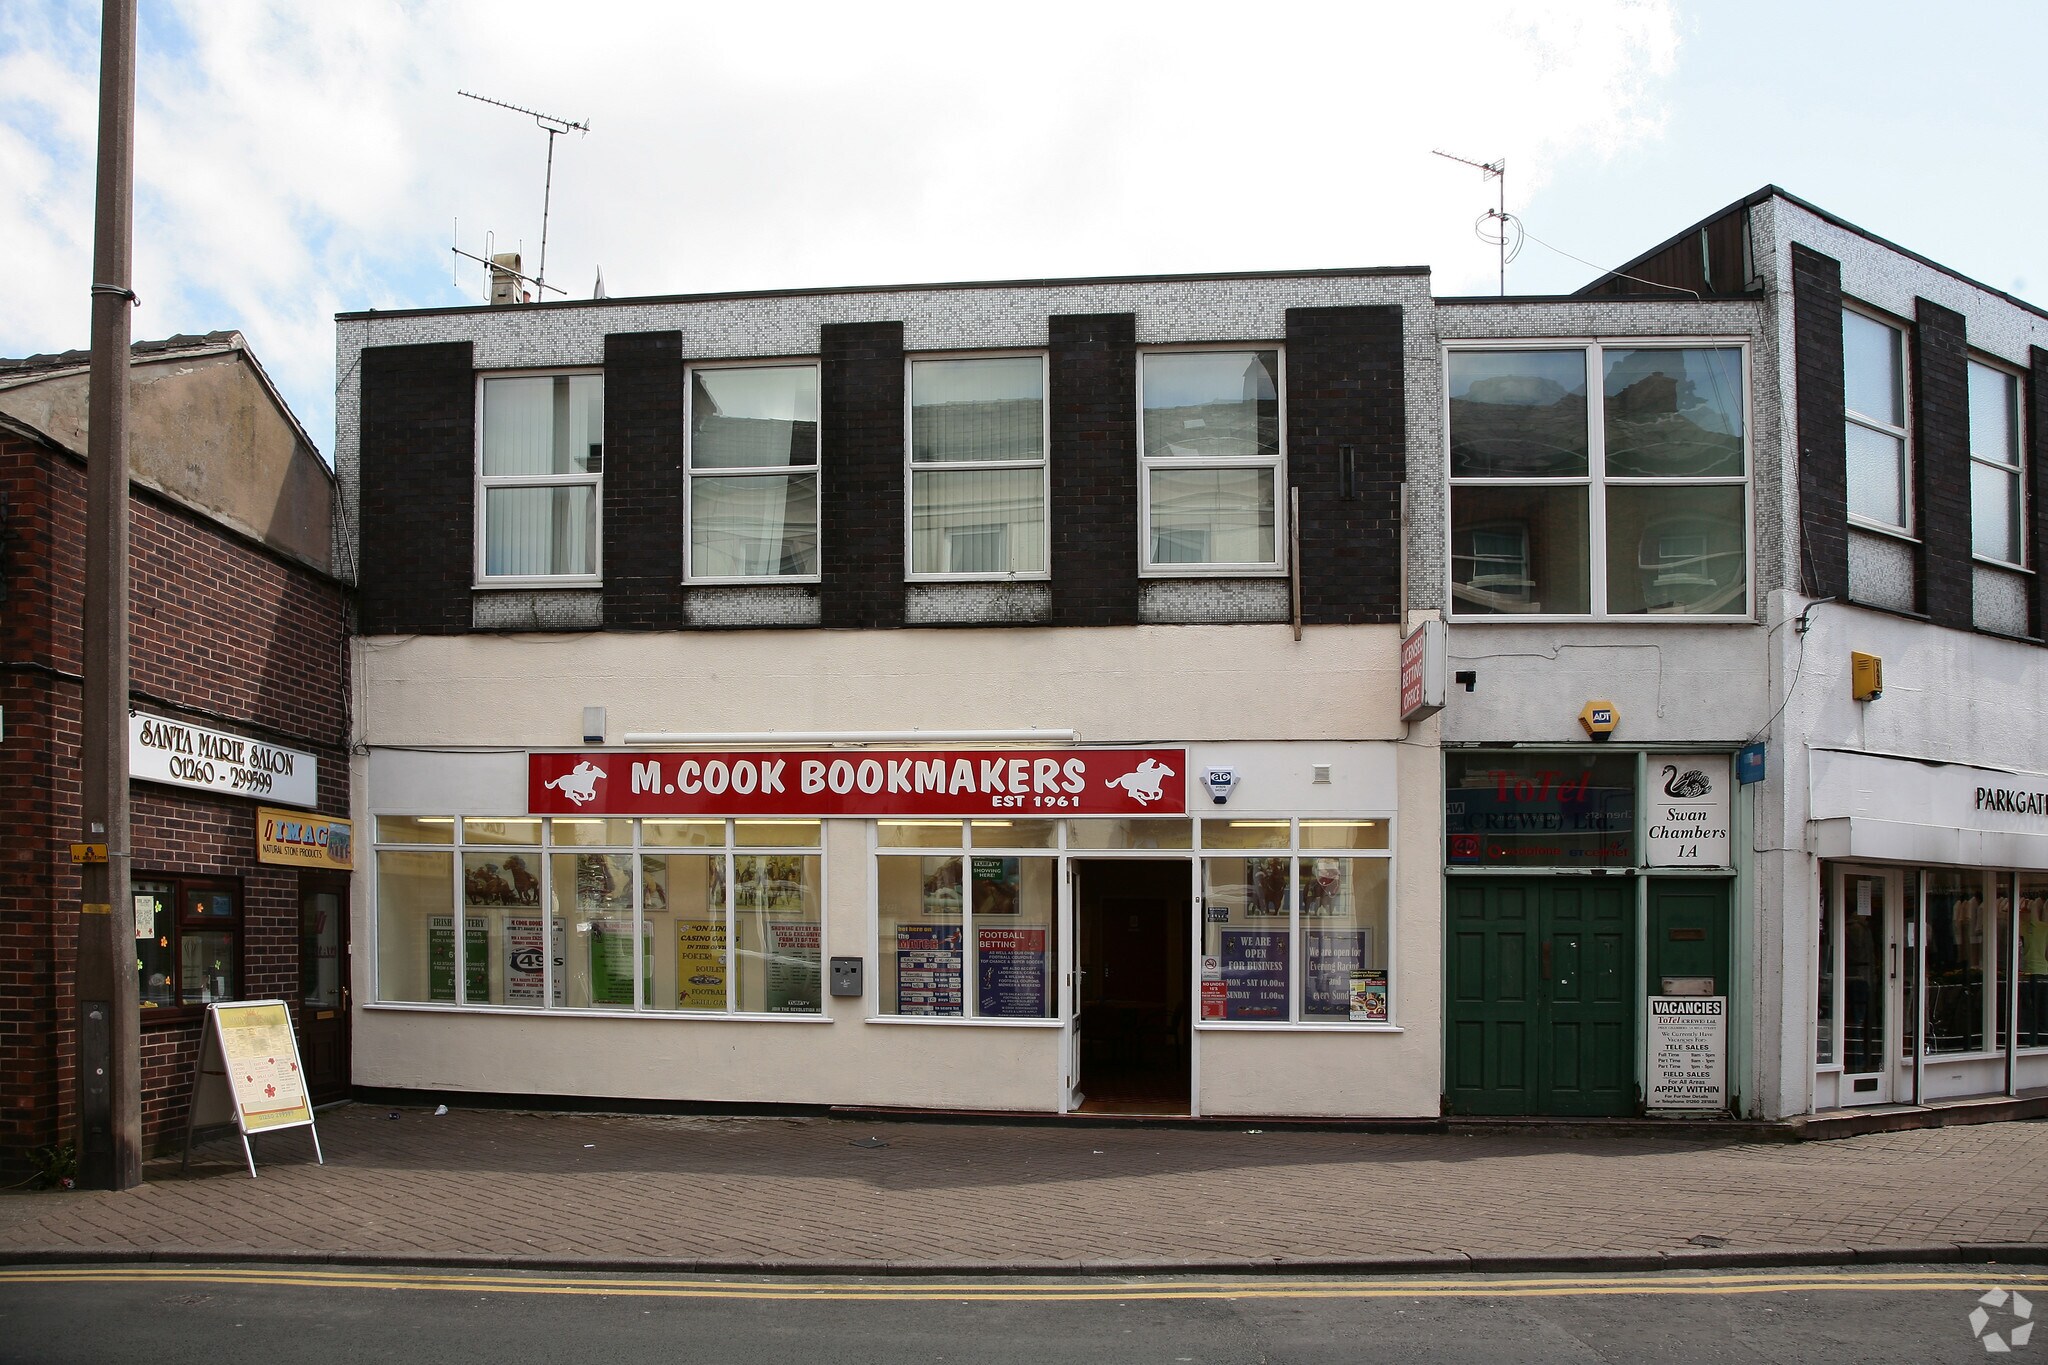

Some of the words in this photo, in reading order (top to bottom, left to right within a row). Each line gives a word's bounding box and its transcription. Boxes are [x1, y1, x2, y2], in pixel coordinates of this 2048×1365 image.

[1402, 634, 1423, 668] LICENSED
[1402, 658, 1422, 690] BETTING
[1403, 683, 1420, 710] OFFICE
[1593, 712, 1610, 721] ADT
[140, 720, 193, 754] SANTA
[198, 733, 244, 764] MARIE
[250, 745, 294, 776] SALON
[169, 756, 214, 784] 01260
[230, 767, 272, 794] 299599
[631, 758, 786, 794] M.COOK
[801, 758, 1086, 795] BOOKMAKERS
[1488, 769, 1593, 804] ToTel
[992, 795, 1025, 807] EST
[1034, 795, 1080, 808] 1961
[1975, 787, 2048, 816] PARKGAT
[1463, 811, 1564, 832] (CREWE)
[1574, 811, 1615, 830] Ltd.
[1666, 808, 1708, 822] Swan
[1648, 825, 1727, 840] Chambers
[262, 844, 282, 855] NATURAL
[284, 846, 298, 856] STONE
[300, 848, 323, 859] PRODUCTS
[1677, 844, 1698, 858] 1A
[433, 918, 452, 927] IRISH
[980, 931, 1025, 939] FOOTBALL
[1241, 936, 1254, 946] WE
[1255, 937, 1271, 946] ARE
[898, 939, 938, 949] MATCH
[1245, 949, 1267, 958] OPEN
[1310, 947, 1319, 957] We
[1321, 949, 1332, 957] are
[1333, 949, 1350, 959] open
[1351, 947, 1361, 957] for
[1229, 961, 1245, 970] FOR
[1247, 961, 1283, 970] BUSINESS
[1310, 961, 1335, 973] Evening
[1329, 976, 1341, 985] and
[1313, 992, 1330, 1001] every
[1332, 990, 1349, 1000] Sund
[1654, 1002, 1721, 1014] VACANCIES
[1654, 1085, 1683, 1093] APPLY
[1686, 1085, 1719, 1093] WITHIN
